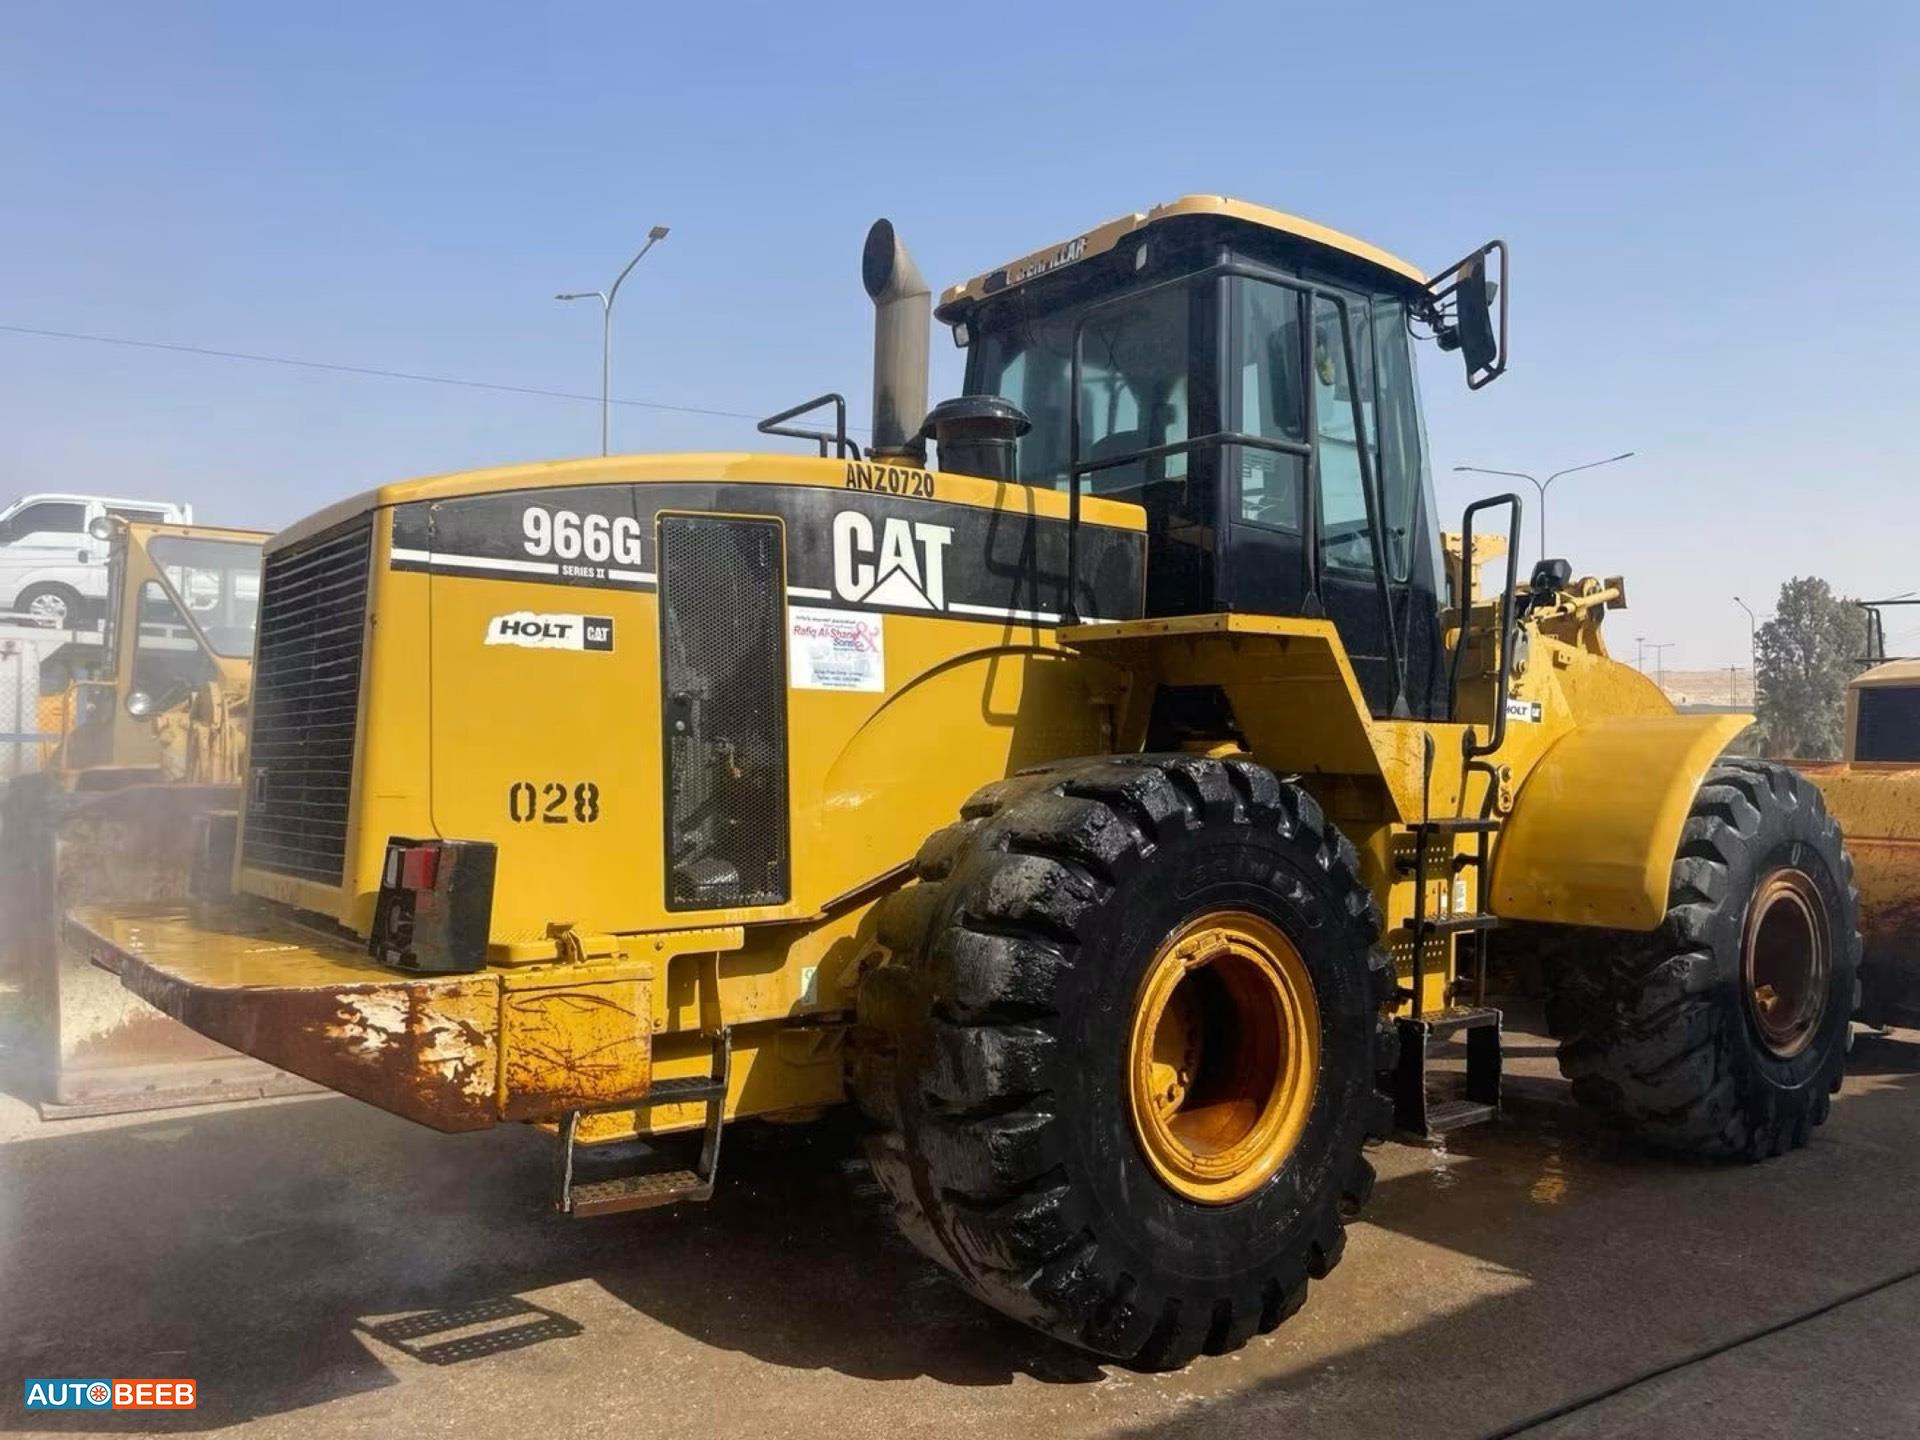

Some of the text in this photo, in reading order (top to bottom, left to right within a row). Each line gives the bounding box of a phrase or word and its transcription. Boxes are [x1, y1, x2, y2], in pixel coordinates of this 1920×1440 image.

[846, 463, 935, 498] ANZ0720
[523, 507, 641, 565] 966G
[562, 564, 595, 578] SERIES
[833, 510, 952, 611] CAT
[500, 620, 610, 641] HOLT CAT
[510, 782, 599, 823] 028
